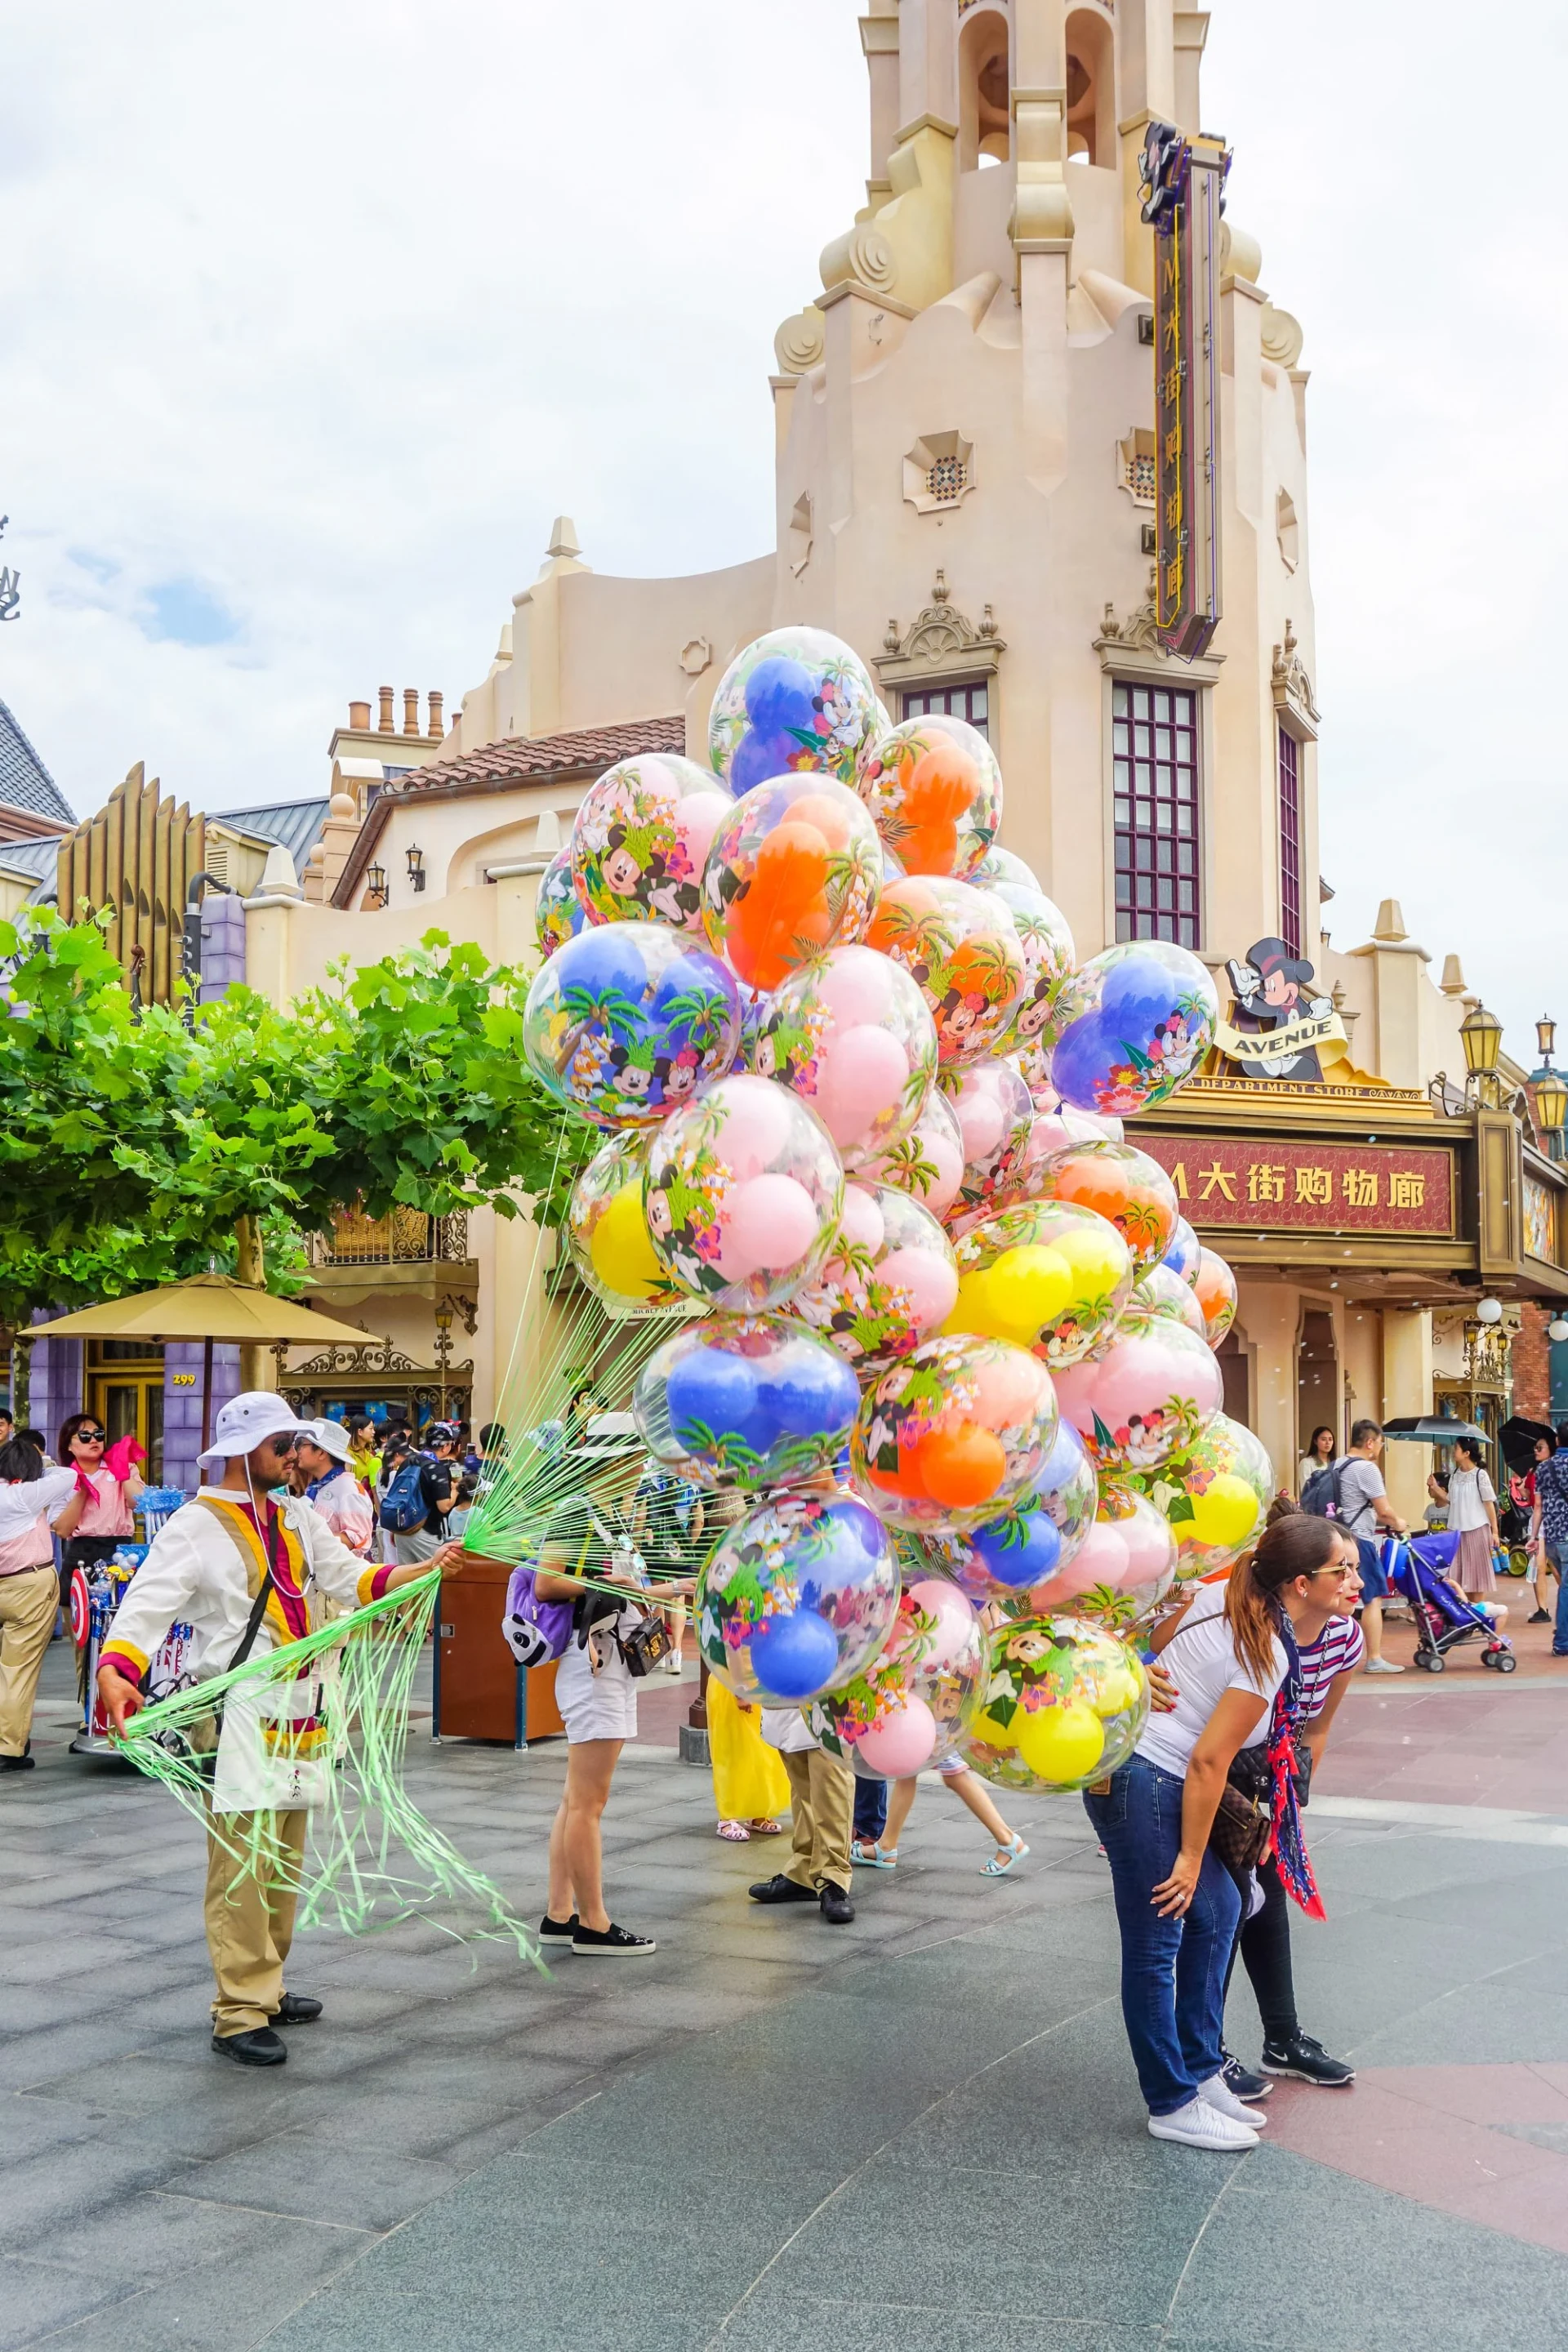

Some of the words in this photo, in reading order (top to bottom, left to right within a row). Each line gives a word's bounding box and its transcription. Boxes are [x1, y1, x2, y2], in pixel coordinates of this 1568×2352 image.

[1234, 1021, 1331, 1054] AVENUE
[1200, 1079, 1308, 1094] DEPARTMENT
[1313, 1085, 1364, 1098] STORE
[173, 1374, 196, 1386] 299
